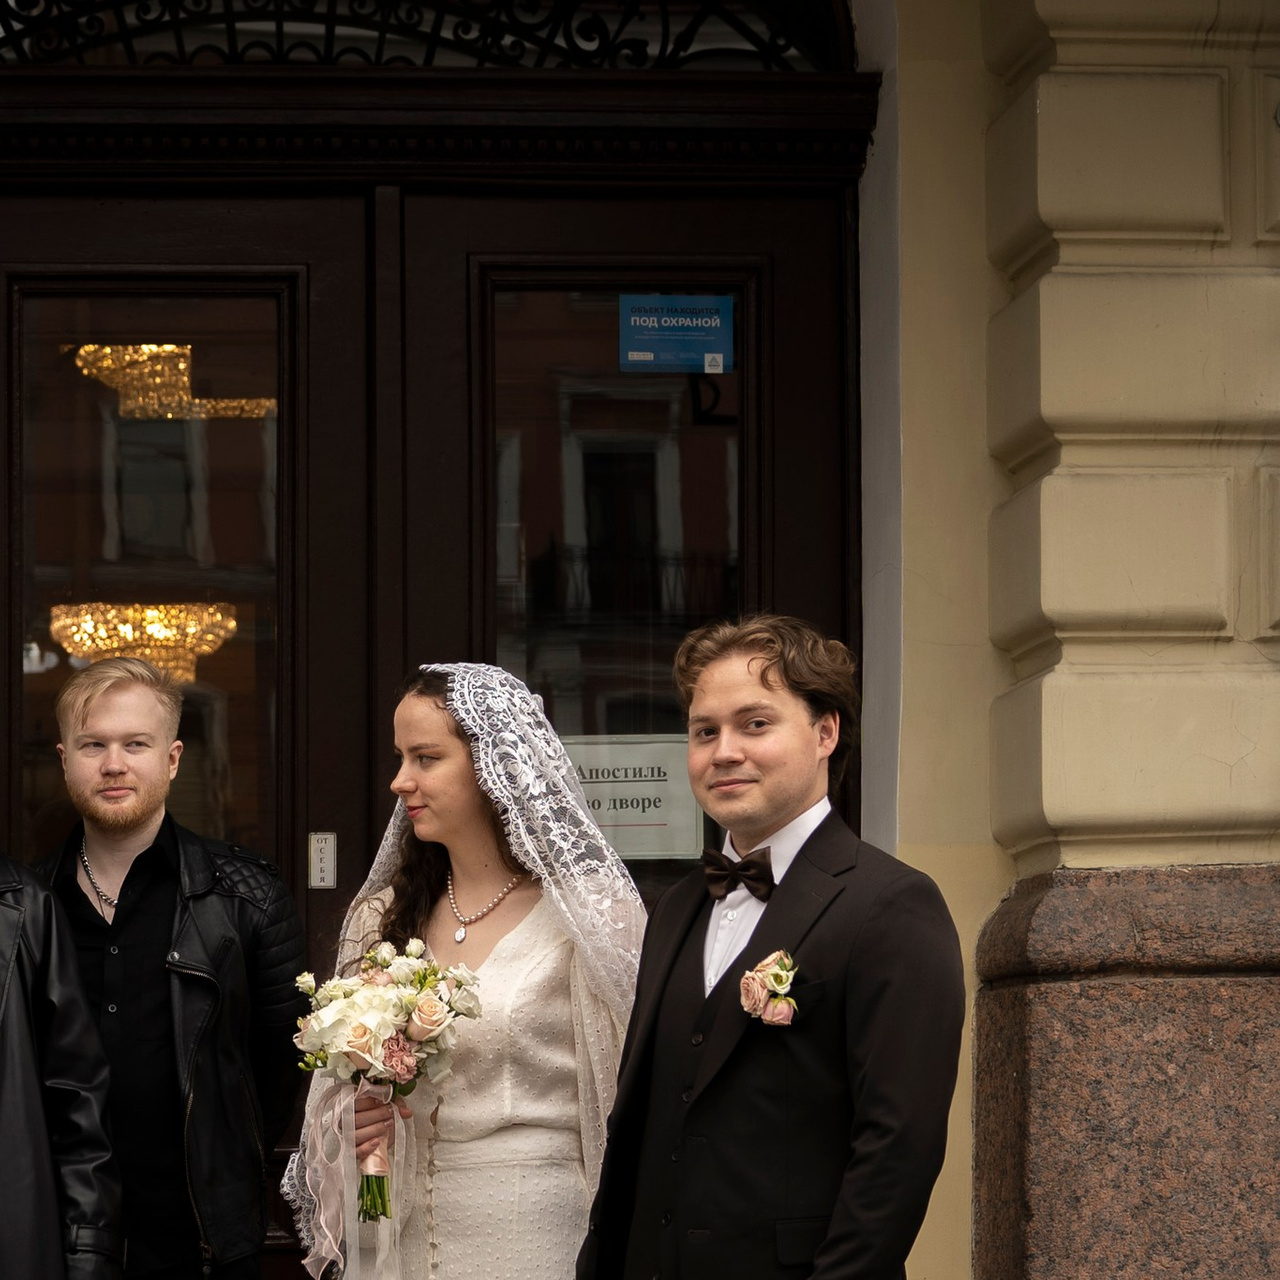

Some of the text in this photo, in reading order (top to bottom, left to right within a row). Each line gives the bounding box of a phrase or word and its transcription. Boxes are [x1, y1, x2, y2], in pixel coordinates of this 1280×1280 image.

[630, 306, 720, 316] ОБЪЕКТ НАХОДИТСЯ
[631, 315, 721, 328] ПОД ОХРАНОЙ
[576, 765, 668, 780] Апостиль
[607, 796, 663, 813] дворе
[316, 837, 329, 845] ОТ
